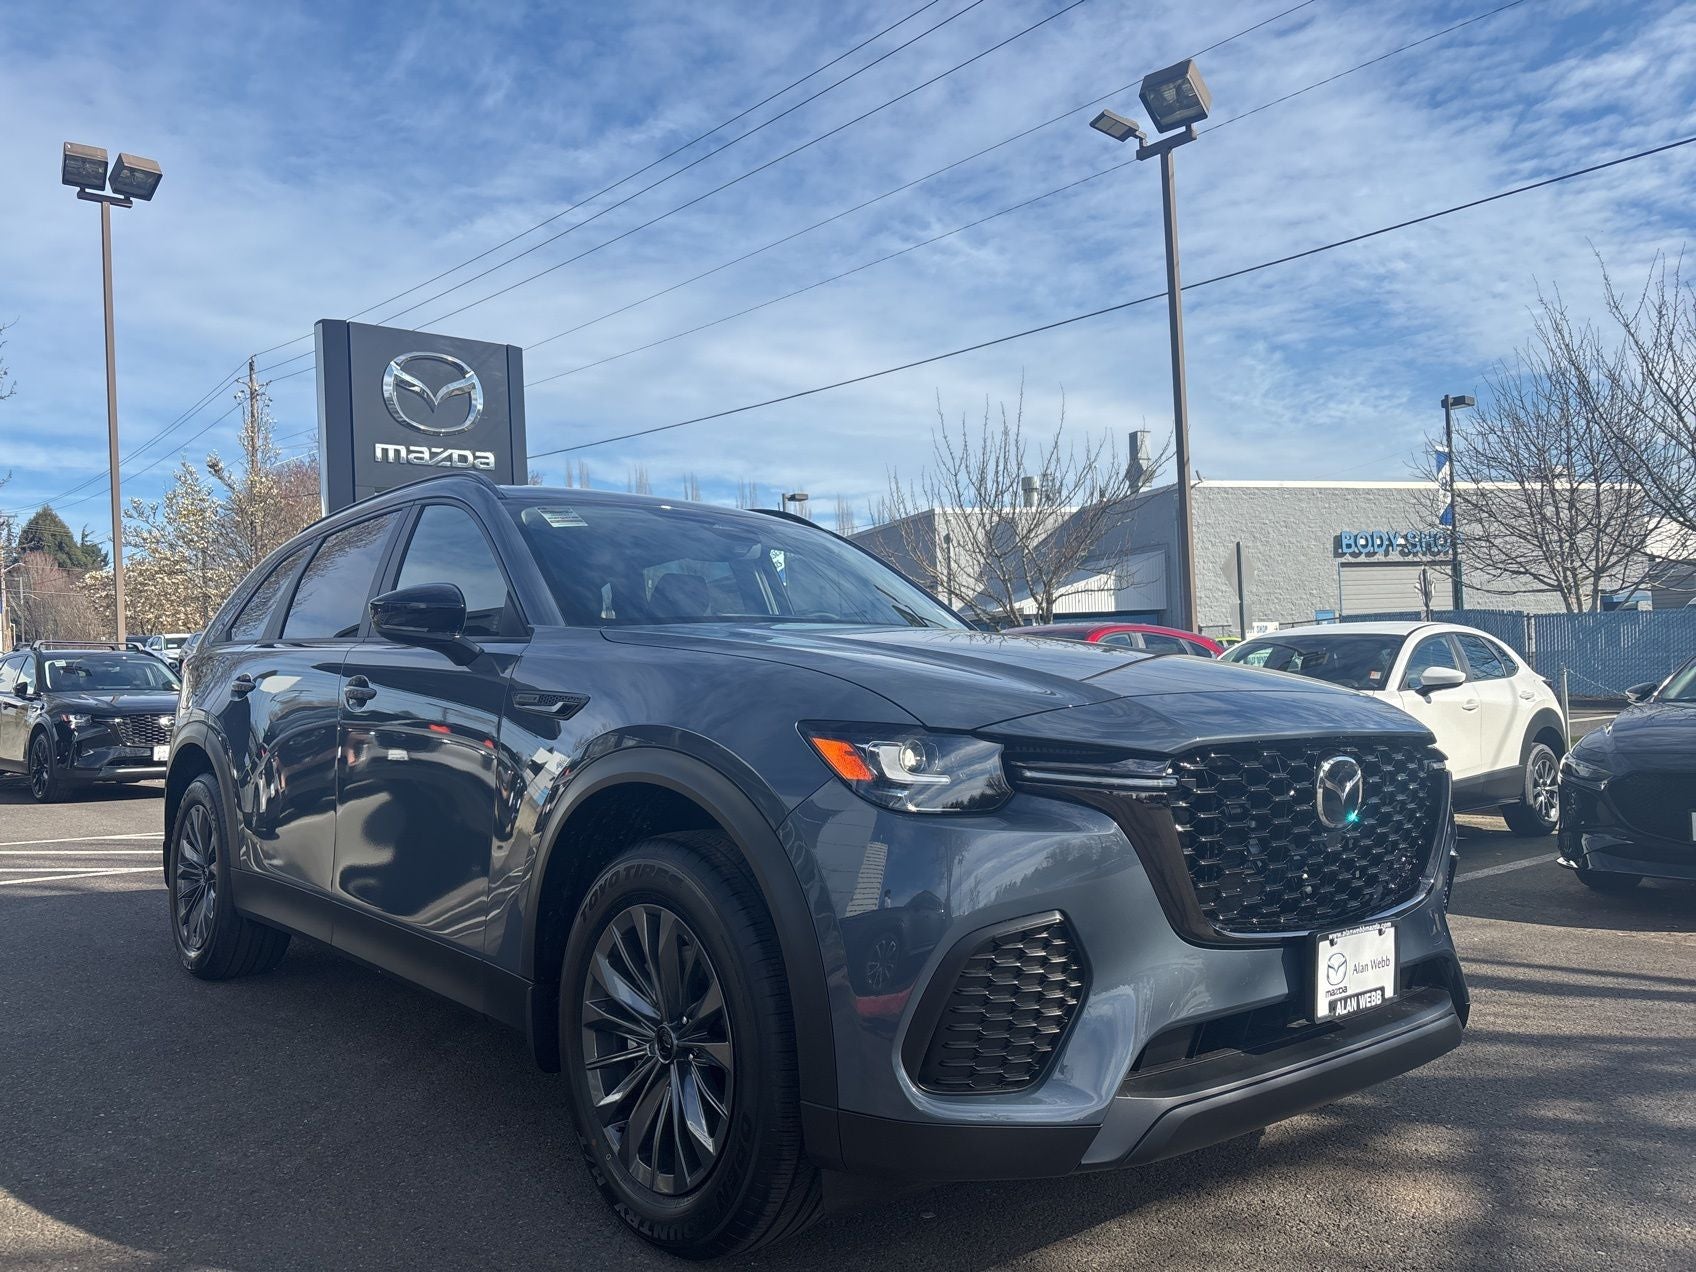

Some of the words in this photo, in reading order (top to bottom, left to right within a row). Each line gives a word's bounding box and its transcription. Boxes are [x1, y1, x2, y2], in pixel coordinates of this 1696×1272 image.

[1340, 530, 1400, 553] BODY
[1352, 961, 1369, 976] Alan
[1370, 956, 1391, 972] Webb
[1335, 996, 1357, 1016] ALAN
[1358, 989, 1382, 1010] WEBB
